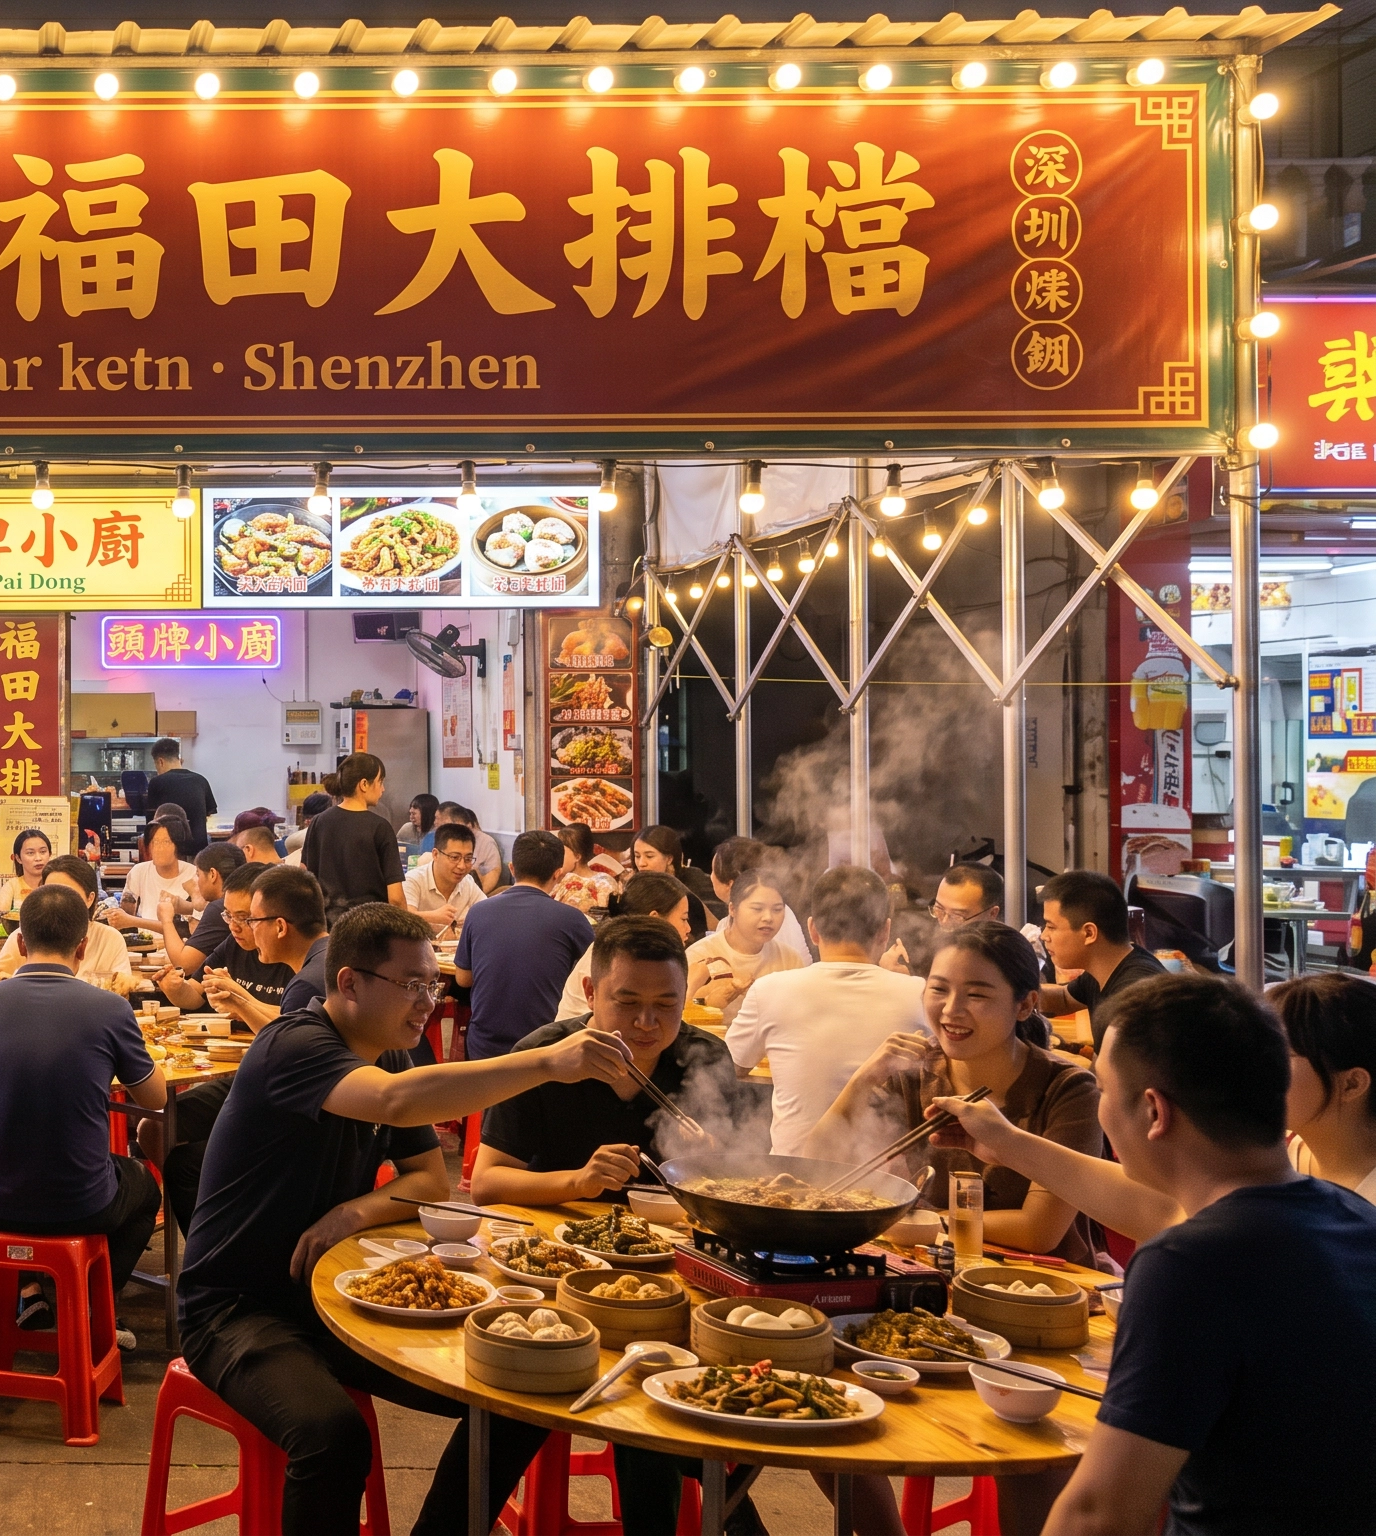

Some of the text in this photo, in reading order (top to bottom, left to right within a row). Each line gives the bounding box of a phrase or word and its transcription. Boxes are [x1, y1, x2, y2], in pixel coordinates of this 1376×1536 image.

[243, 340, 542, 391] Shenzhen
[29, 573, 87, 595] Dong
[106, 622, 278, 662] 頭牌小廚
